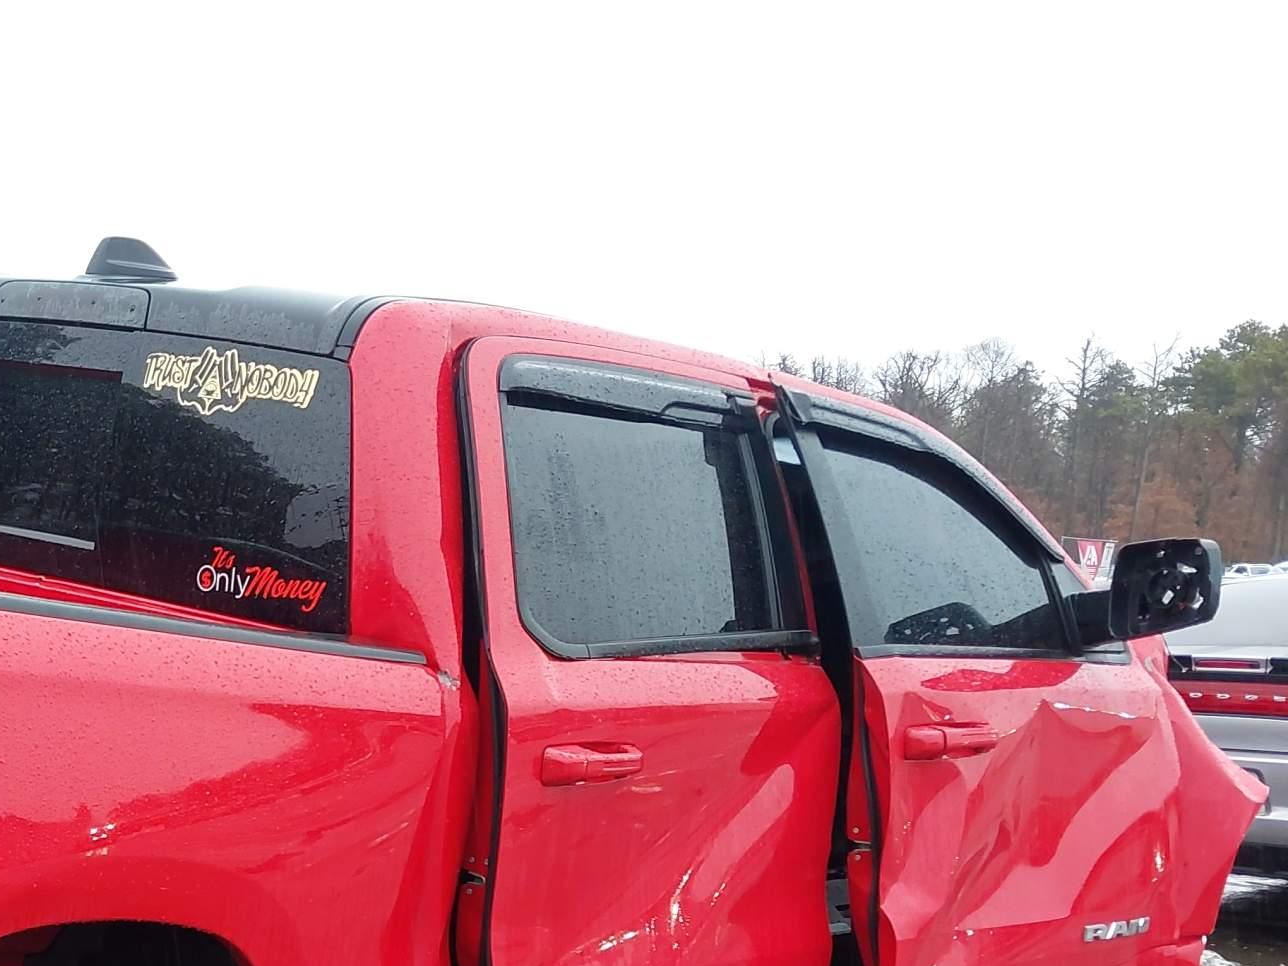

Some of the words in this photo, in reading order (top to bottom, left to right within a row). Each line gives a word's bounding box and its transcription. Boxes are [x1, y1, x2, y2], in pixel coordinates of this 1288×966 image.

[144, 353, 201, 391] TRUST
[232, 361, 319, 408] NOBODY
[244, 567, 326, 611] Money
[1189, 692, 1288, 702] DODGE
[1084, 917, 1150, 942] RAM
